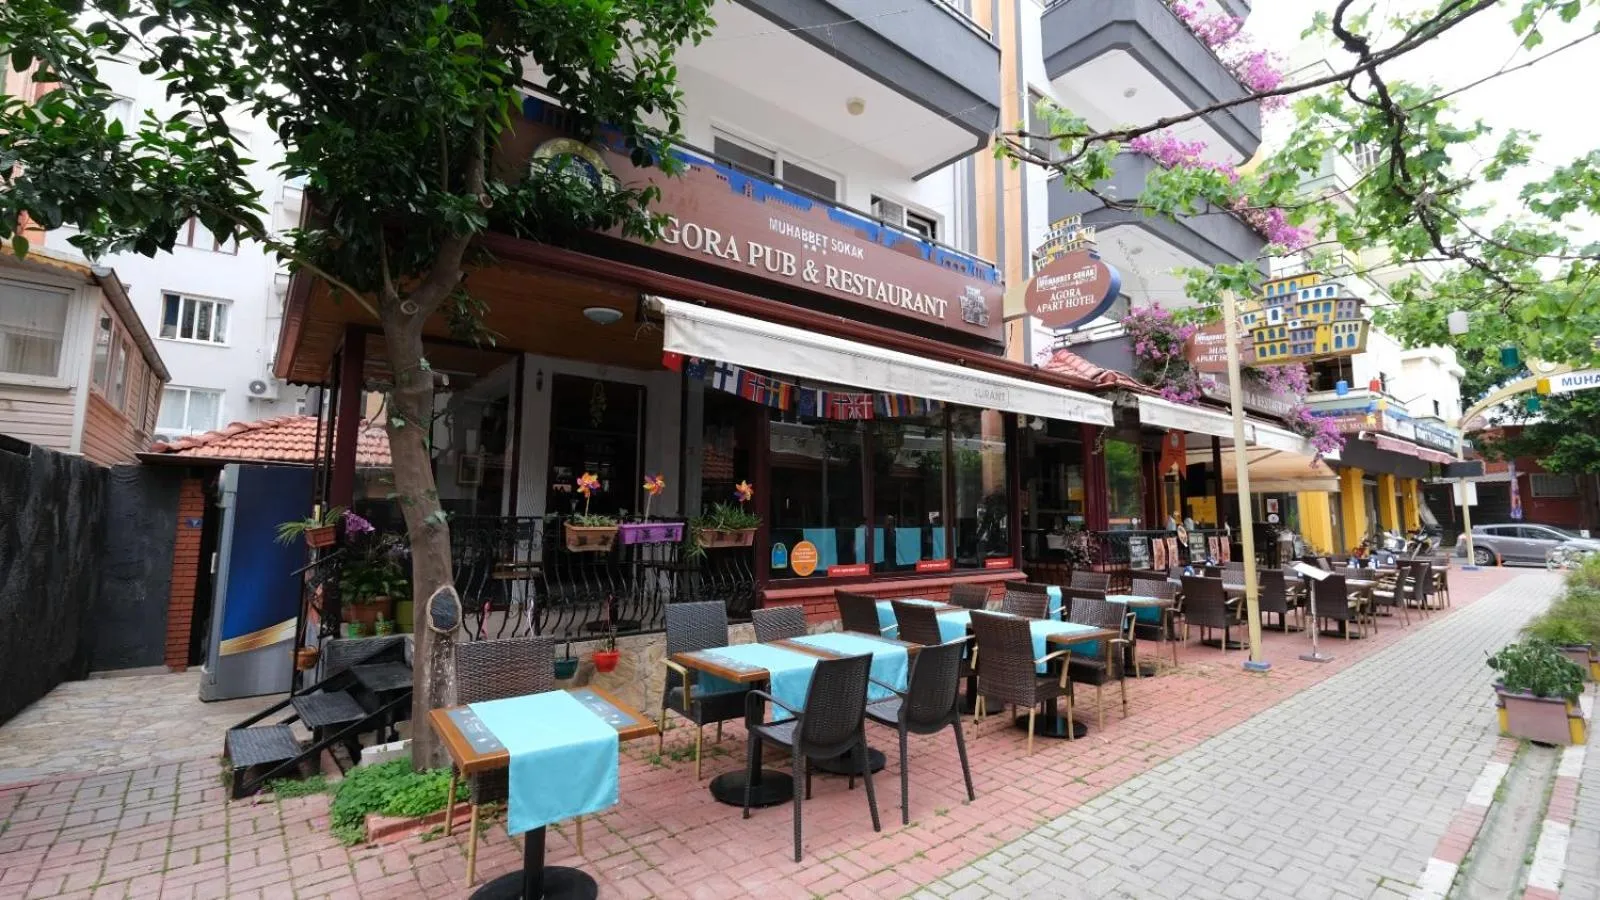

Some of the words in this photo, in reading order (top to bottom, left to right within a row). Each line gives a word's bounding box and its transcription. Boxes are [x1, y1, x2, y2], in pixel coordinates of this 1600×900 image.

[768, 217, 828, 248] MUHABBET
[830, 237, 865, 261] SOKAK
[746, 240, 798, 278] PUB
[802, 258, 821, 285] &
[824, 263, 949, 320] RESTAURANT
[1049, 287, 1082, 302] AGORA
[1036, 300, 1065, 313] APART
[1065, 294, 1097, 308] HOTEL
